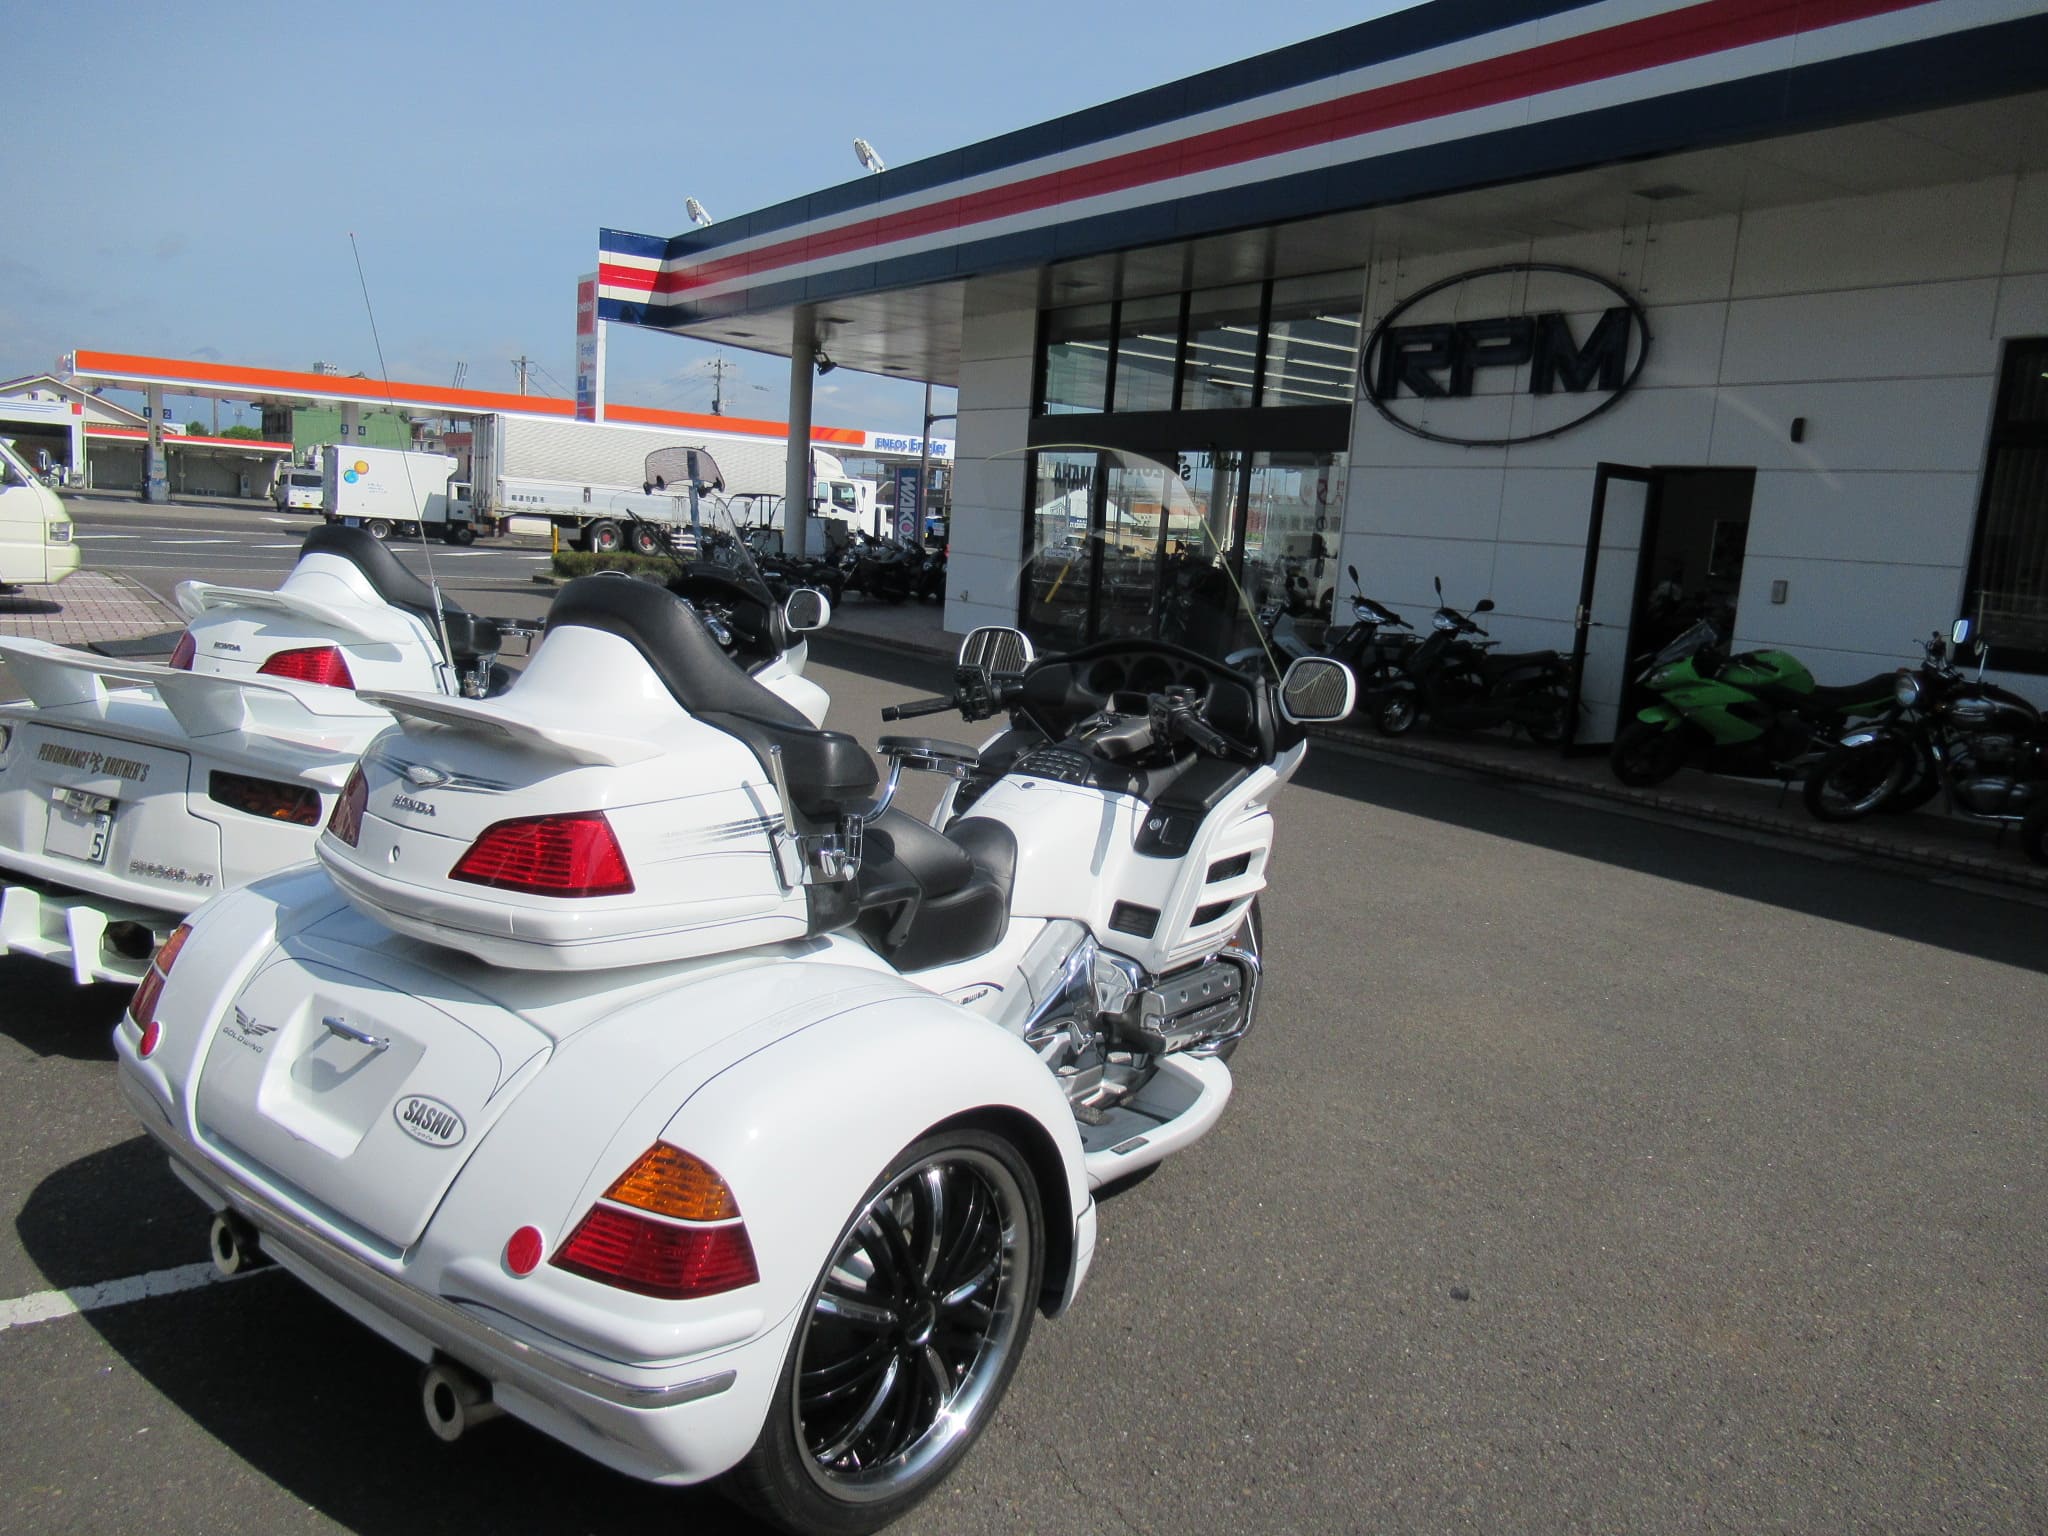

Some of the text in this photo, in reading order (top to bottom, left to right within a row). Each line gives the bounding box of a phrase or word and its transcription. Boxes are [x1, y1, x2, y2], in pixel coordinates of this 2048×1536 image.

[1376, 306, 1632, 400] RPM
[875, 438, 947, 456] ENEOS EnJet
[37, 743, 150, 782] PERFORMANCE BROTHER'S
[392, 793, 436, 817] HONDA
[91, 833, 105, 859] 5
[403, 1099, 458, 1140] SASHU
